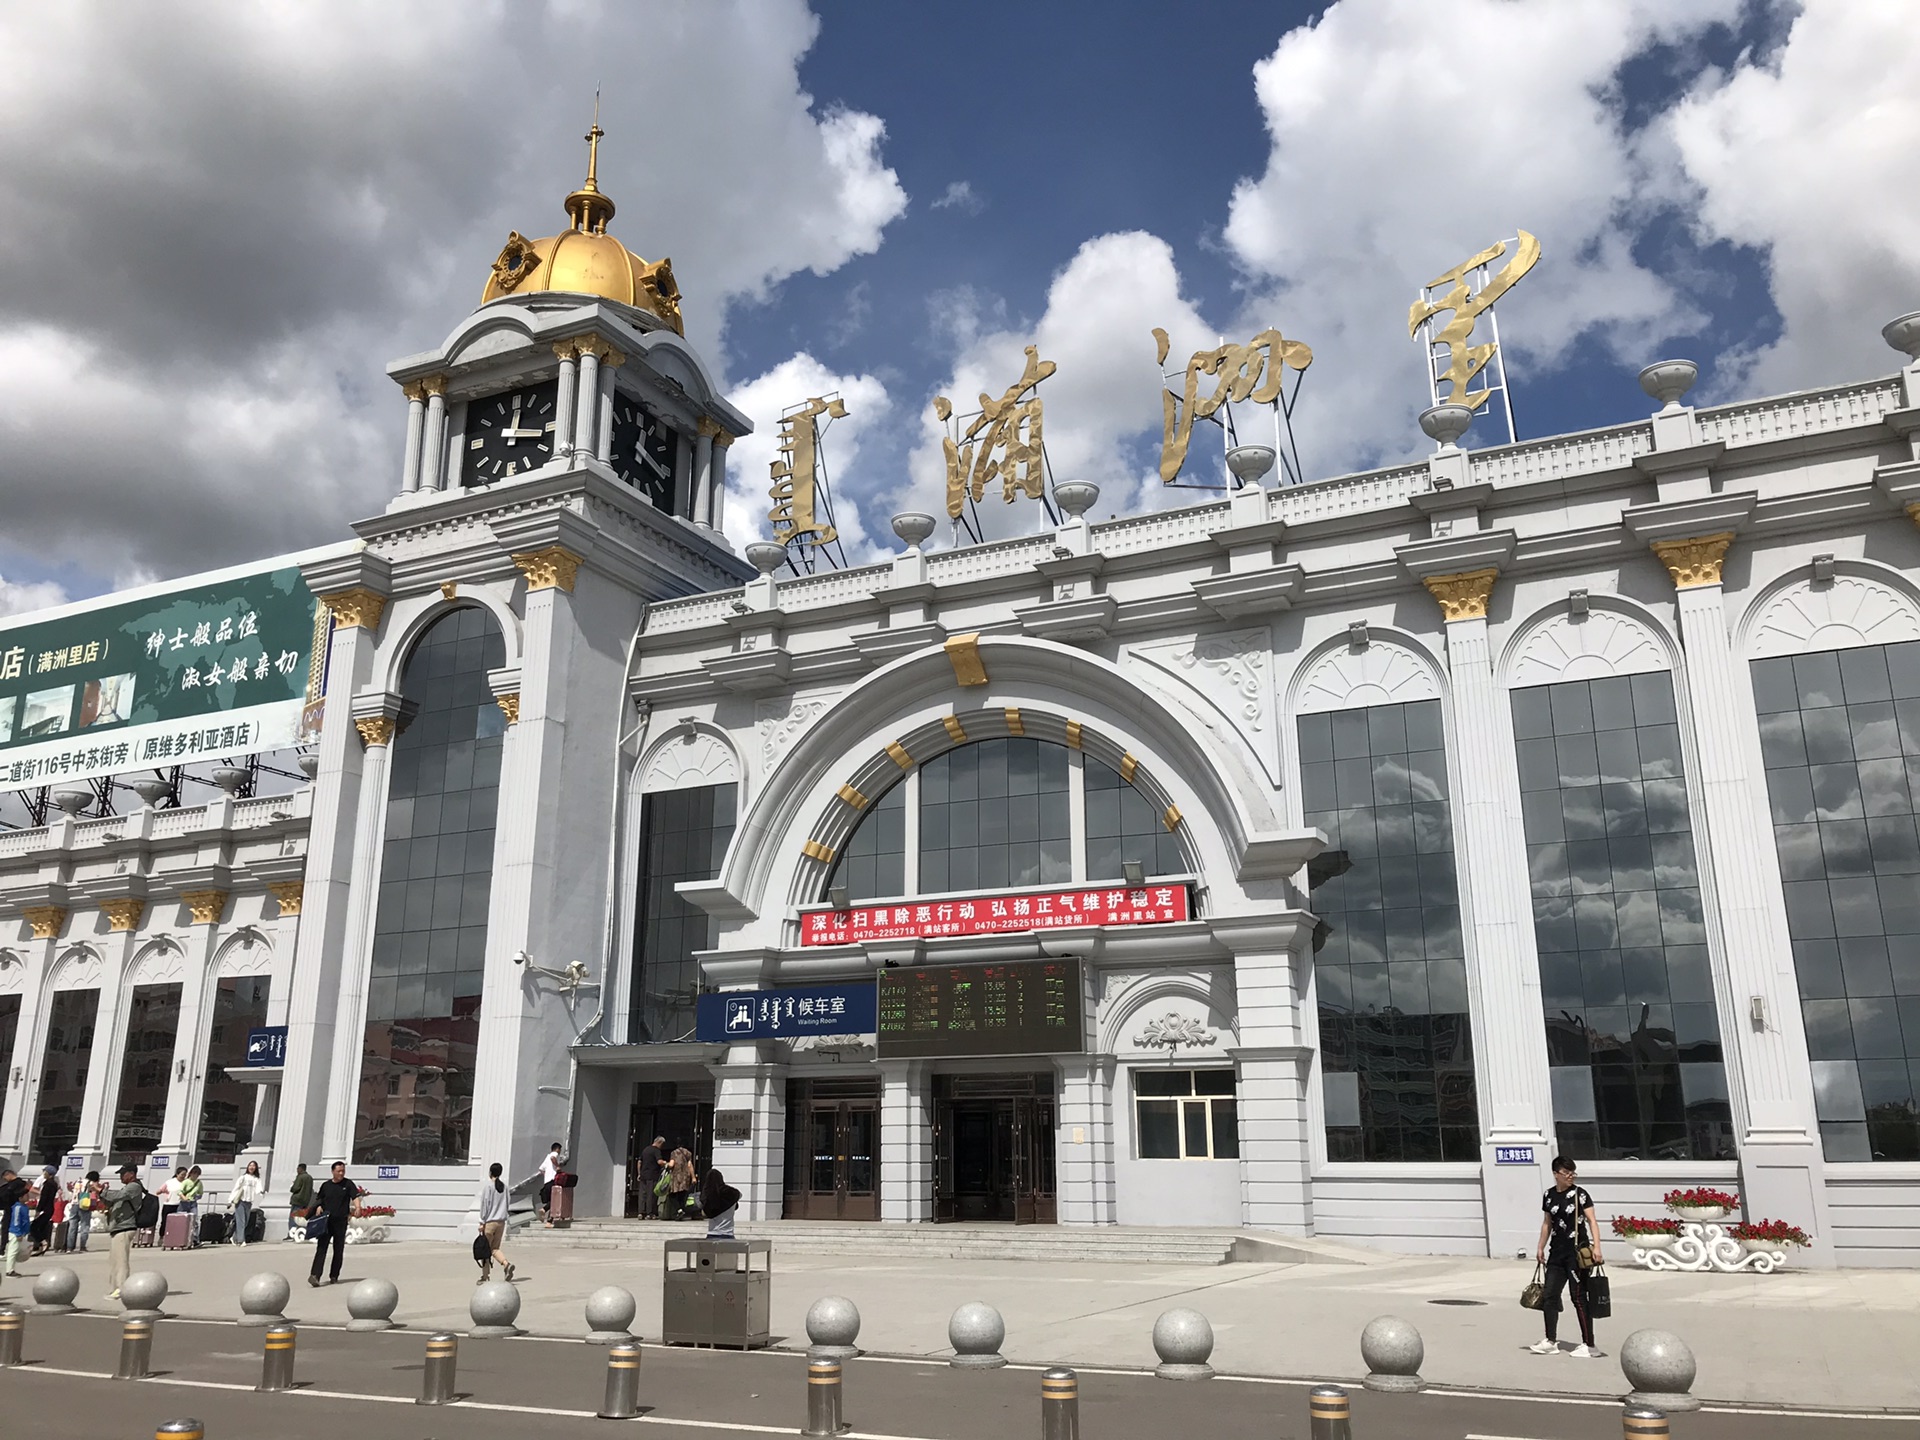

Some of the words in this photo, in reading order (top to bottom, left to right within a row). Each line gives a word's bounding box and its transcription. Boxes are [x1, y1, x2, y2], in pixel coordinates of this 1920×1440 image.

[146, 611, 258, 658] 绅士般品位
[181, 650, 299, 690] 淑女般亲切
[812, 902, 975, 931] 深化扫黑除恶行动
[991, 888, 1173, 917] 弘扬正气维护稳定
[1108, 910, 1156, 922] 满洲里站
[798, 996, 845, 1016] 候车室
[798, 1018, 819, 1026] Waiting
[820, 1017, 838, 1025] Room
[1497, 1149, 1533, 1161] 禁止停放车辆
